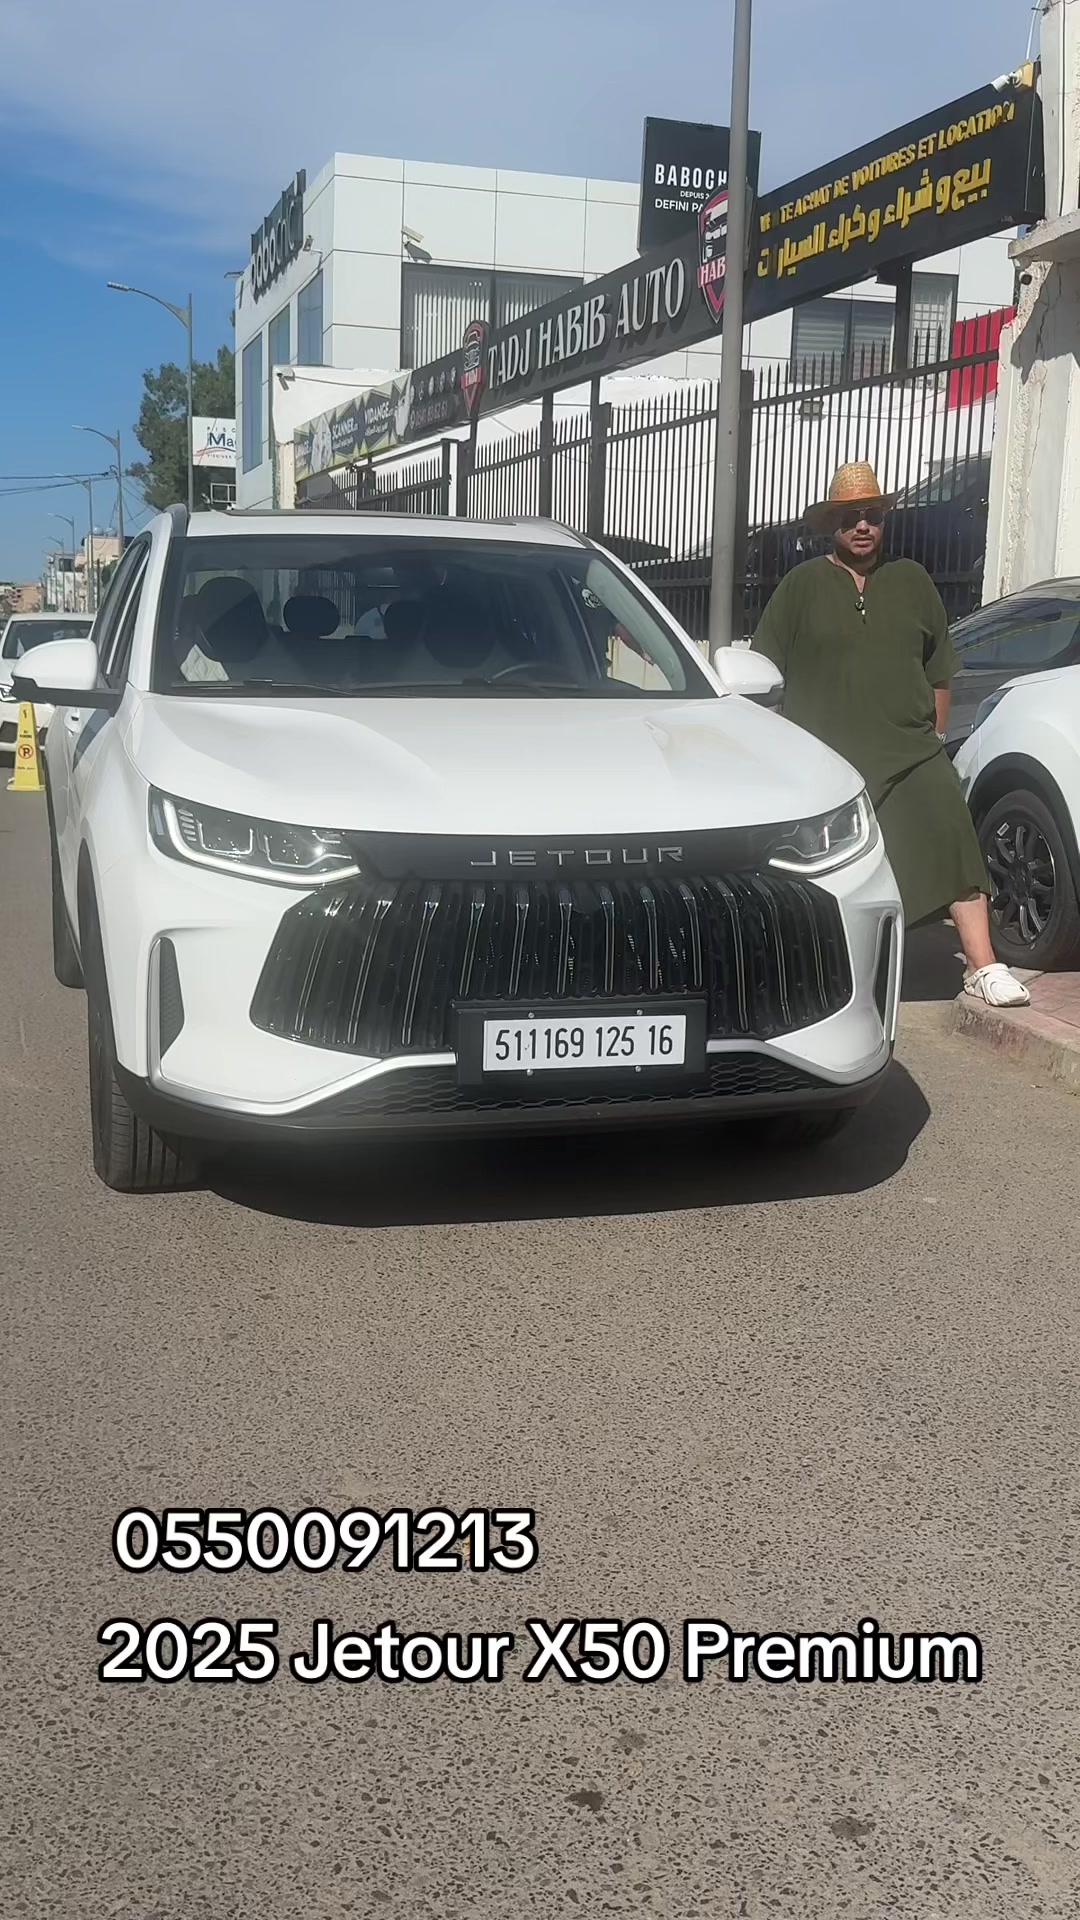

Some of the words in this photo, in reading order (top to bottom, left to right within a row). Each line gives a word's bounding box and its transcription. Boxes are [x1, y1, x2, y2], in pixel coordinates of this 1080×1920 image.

[794, 183, 832, 218] ACHAT
[833, 175, 849, 199] DE
[851, 143, 916, 192] VOITURES
[917, 132, 937, 160] ET
[937, 100, 1015, 151] LOCATION
[654, 163, 728, 190] BABOCH
[951, 158, 991, 211] بيع
[655, 198, 689, 212] DEFINI
[680, 190, 705, 200] DEPUIS
[700, 256, 727, 286] HAB
[487, 328, 532, 390] TADJ
[538, 294, 606, 369] HABIB
[615, 257, 685, 338] AUTO
[207, 432, 236, 448] Ma
[470, 846, 684, 866] JETOUR
[495, 1027, 585, 1062] 511169
[595, 1025, 635, 1058] 125
[648, 1024, 673, 1056] 16
